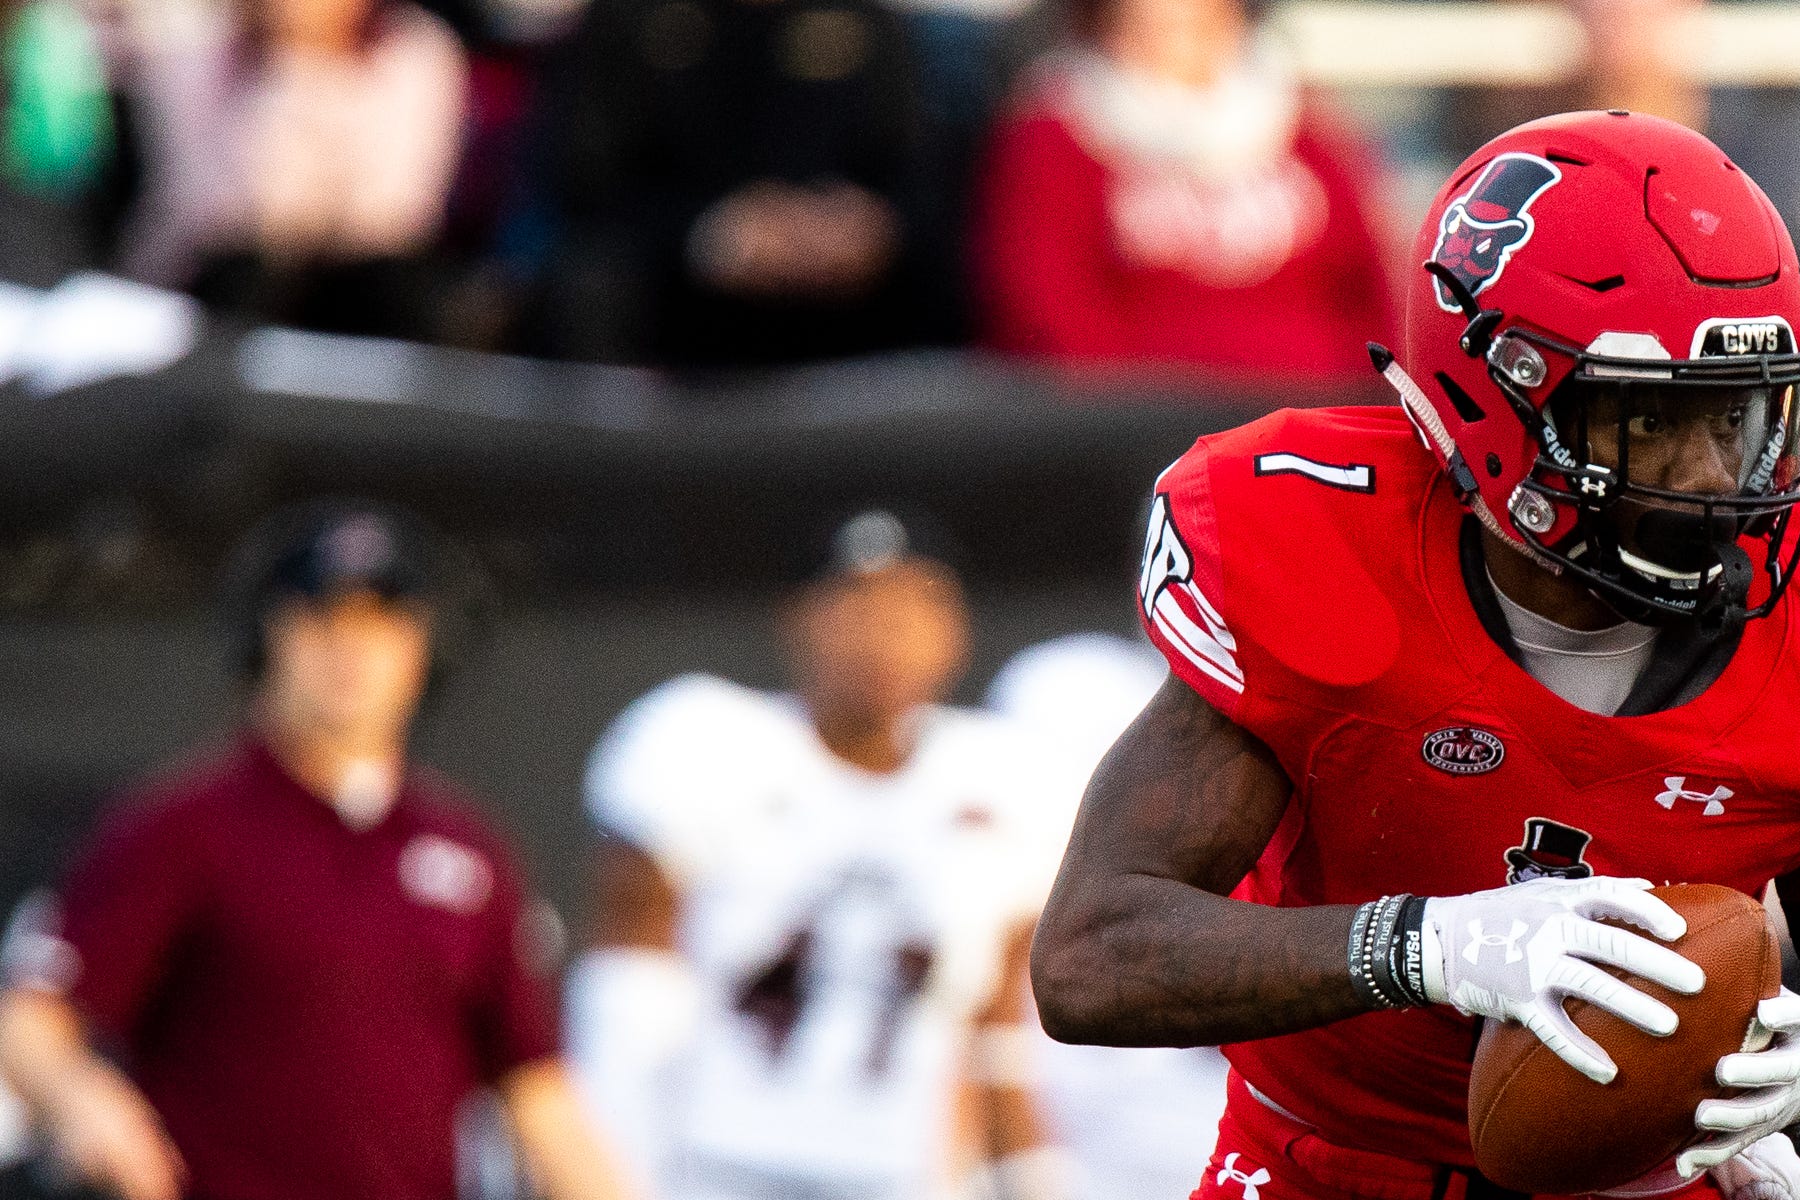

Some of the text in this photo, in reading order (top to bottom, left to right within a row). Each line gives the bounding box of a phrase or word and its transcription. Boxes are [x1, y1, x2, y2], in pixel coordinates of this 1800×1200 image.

[1722, 325, 1778, 354] GOVS
[1254, 450, 1376, 494] 1
[1439, 741, 1488, 760] OVC
[1353, 907, 1370, 932] The
[1383, 899, 1399, 920] The
[1349, 931, 1364, 963] Trust
[1376, 919, 1393, 947] Trust
